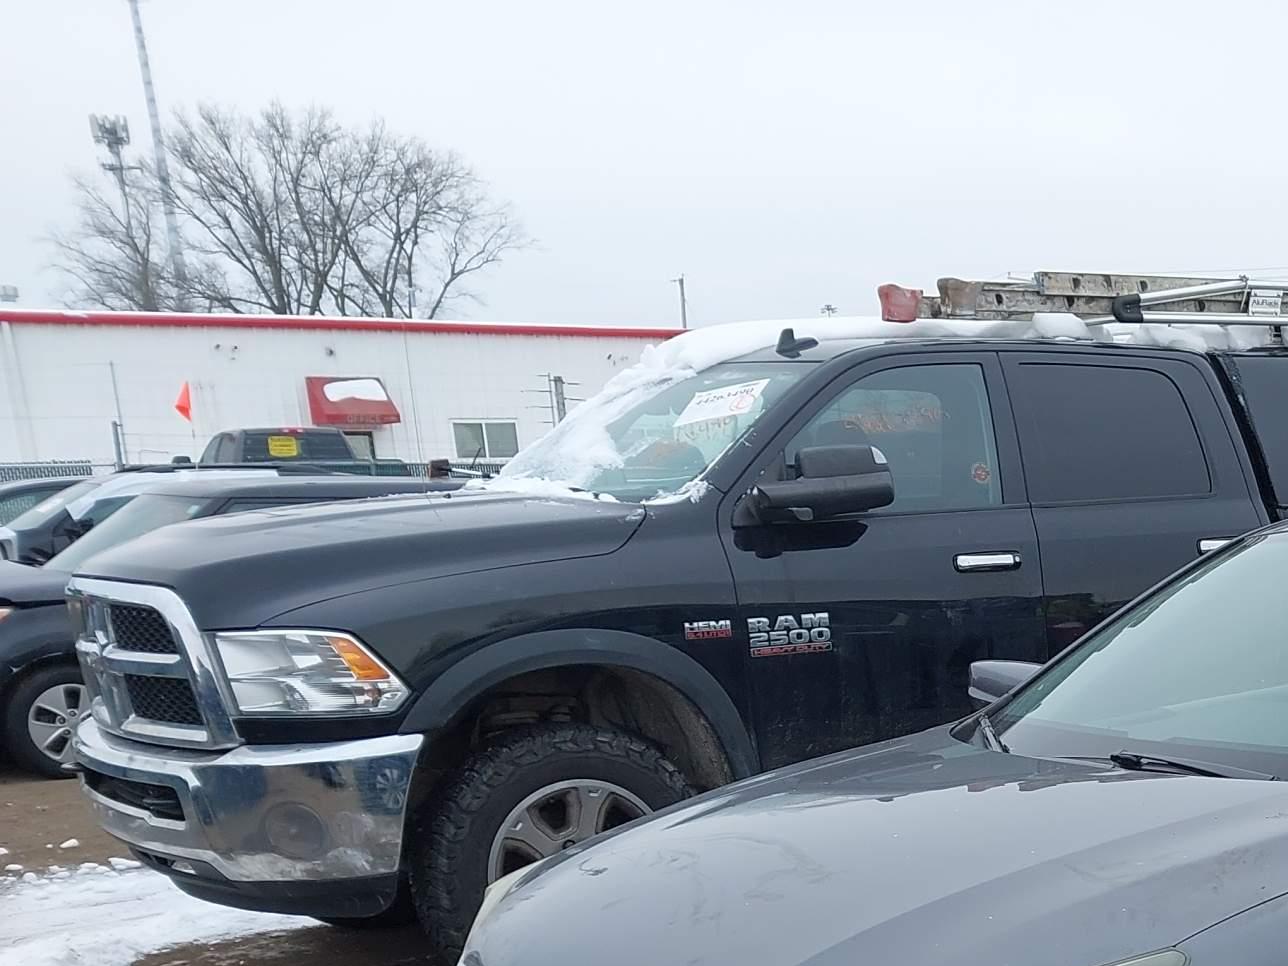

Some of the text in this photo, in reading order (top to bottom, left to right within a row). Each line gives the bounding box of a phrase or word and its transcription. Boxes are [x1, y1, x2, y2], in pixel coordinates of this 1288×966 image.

[684, 620, 731, 633] HEMI
[747, 612, 830, 632] RAM
[750, 627, 831, 647] 2500
